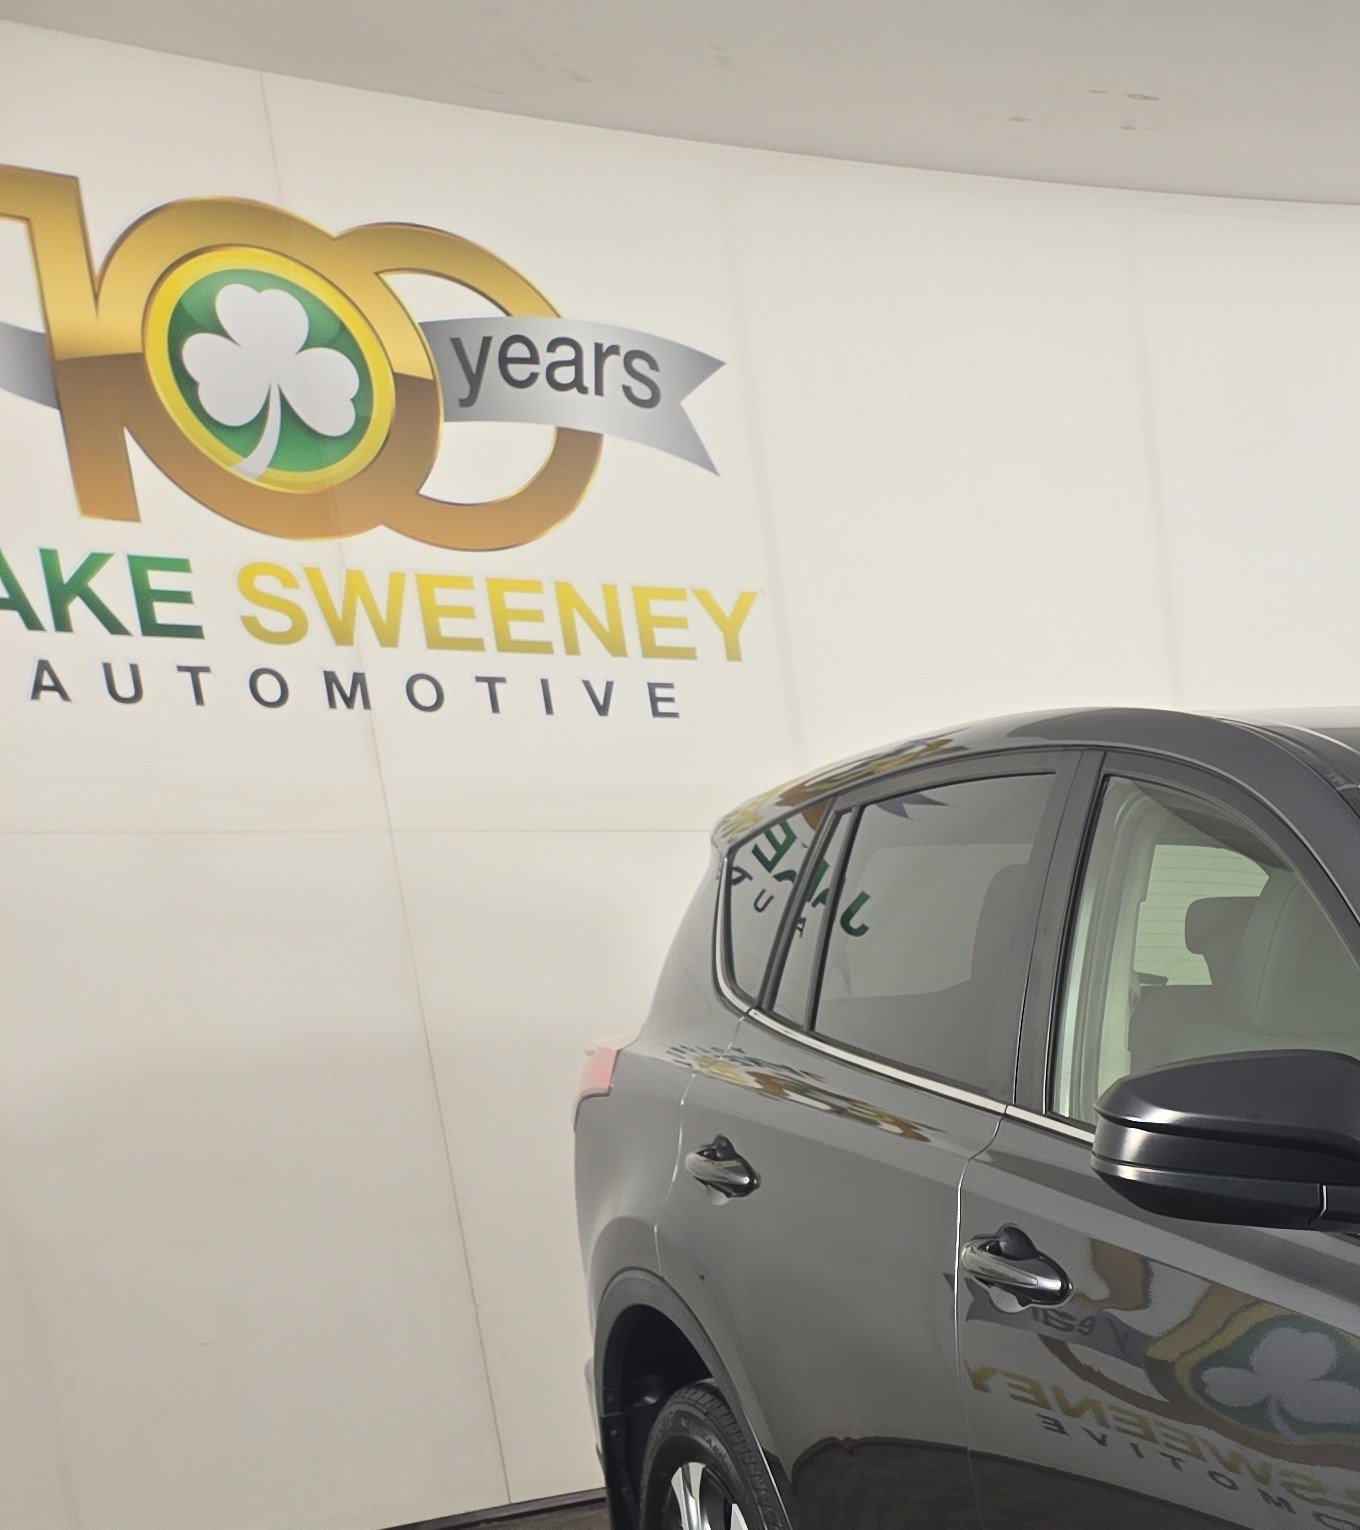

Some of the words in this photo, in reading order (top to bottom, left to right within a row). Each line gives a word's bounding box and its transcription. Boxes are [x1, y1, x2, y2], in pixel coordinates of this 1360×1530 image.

[450, 333, 662, 410] years
[0, 547, 205, 640] AKE
[236, 561, 758, 663] SWEENEY
[29, 658, 681, 720] AUTOMOTIVE
